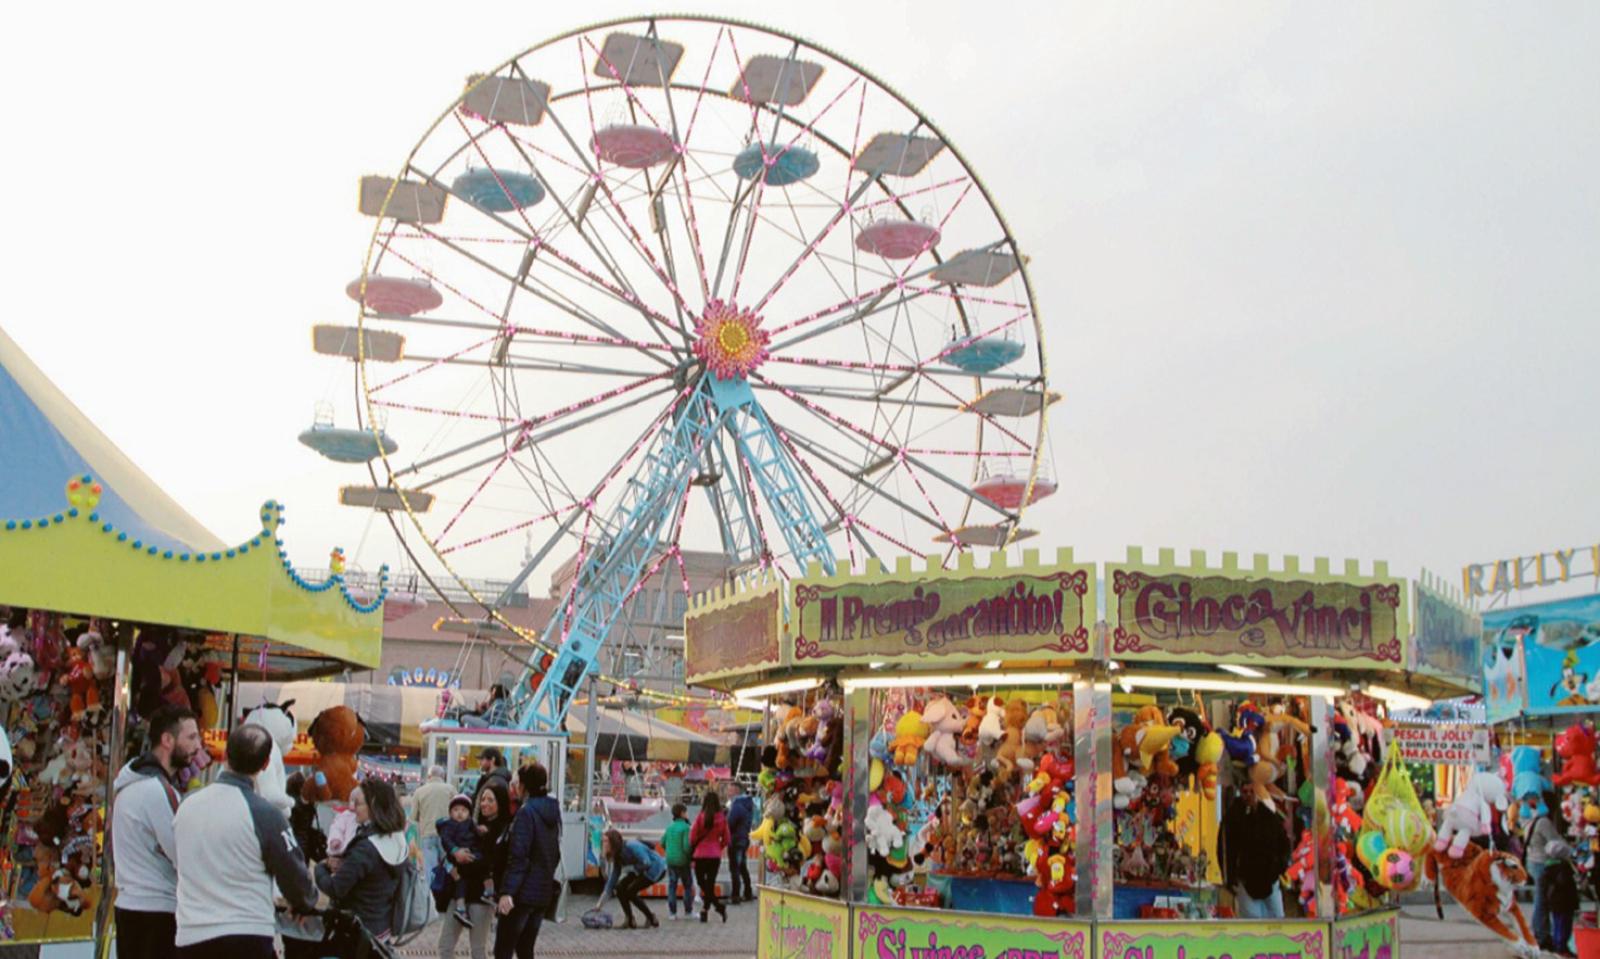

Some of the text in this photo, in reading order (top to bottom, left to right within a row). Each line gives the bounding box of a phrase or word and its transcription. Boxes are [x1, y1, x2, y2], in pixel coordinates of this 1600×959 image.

[1462, 548, 1574, 598] RALLY
[1136, 582, 1272, 641] Gioca
[1394, 729, 1425, 740] PESCA
[1406, 741, 1448, 749] DIRITTO
